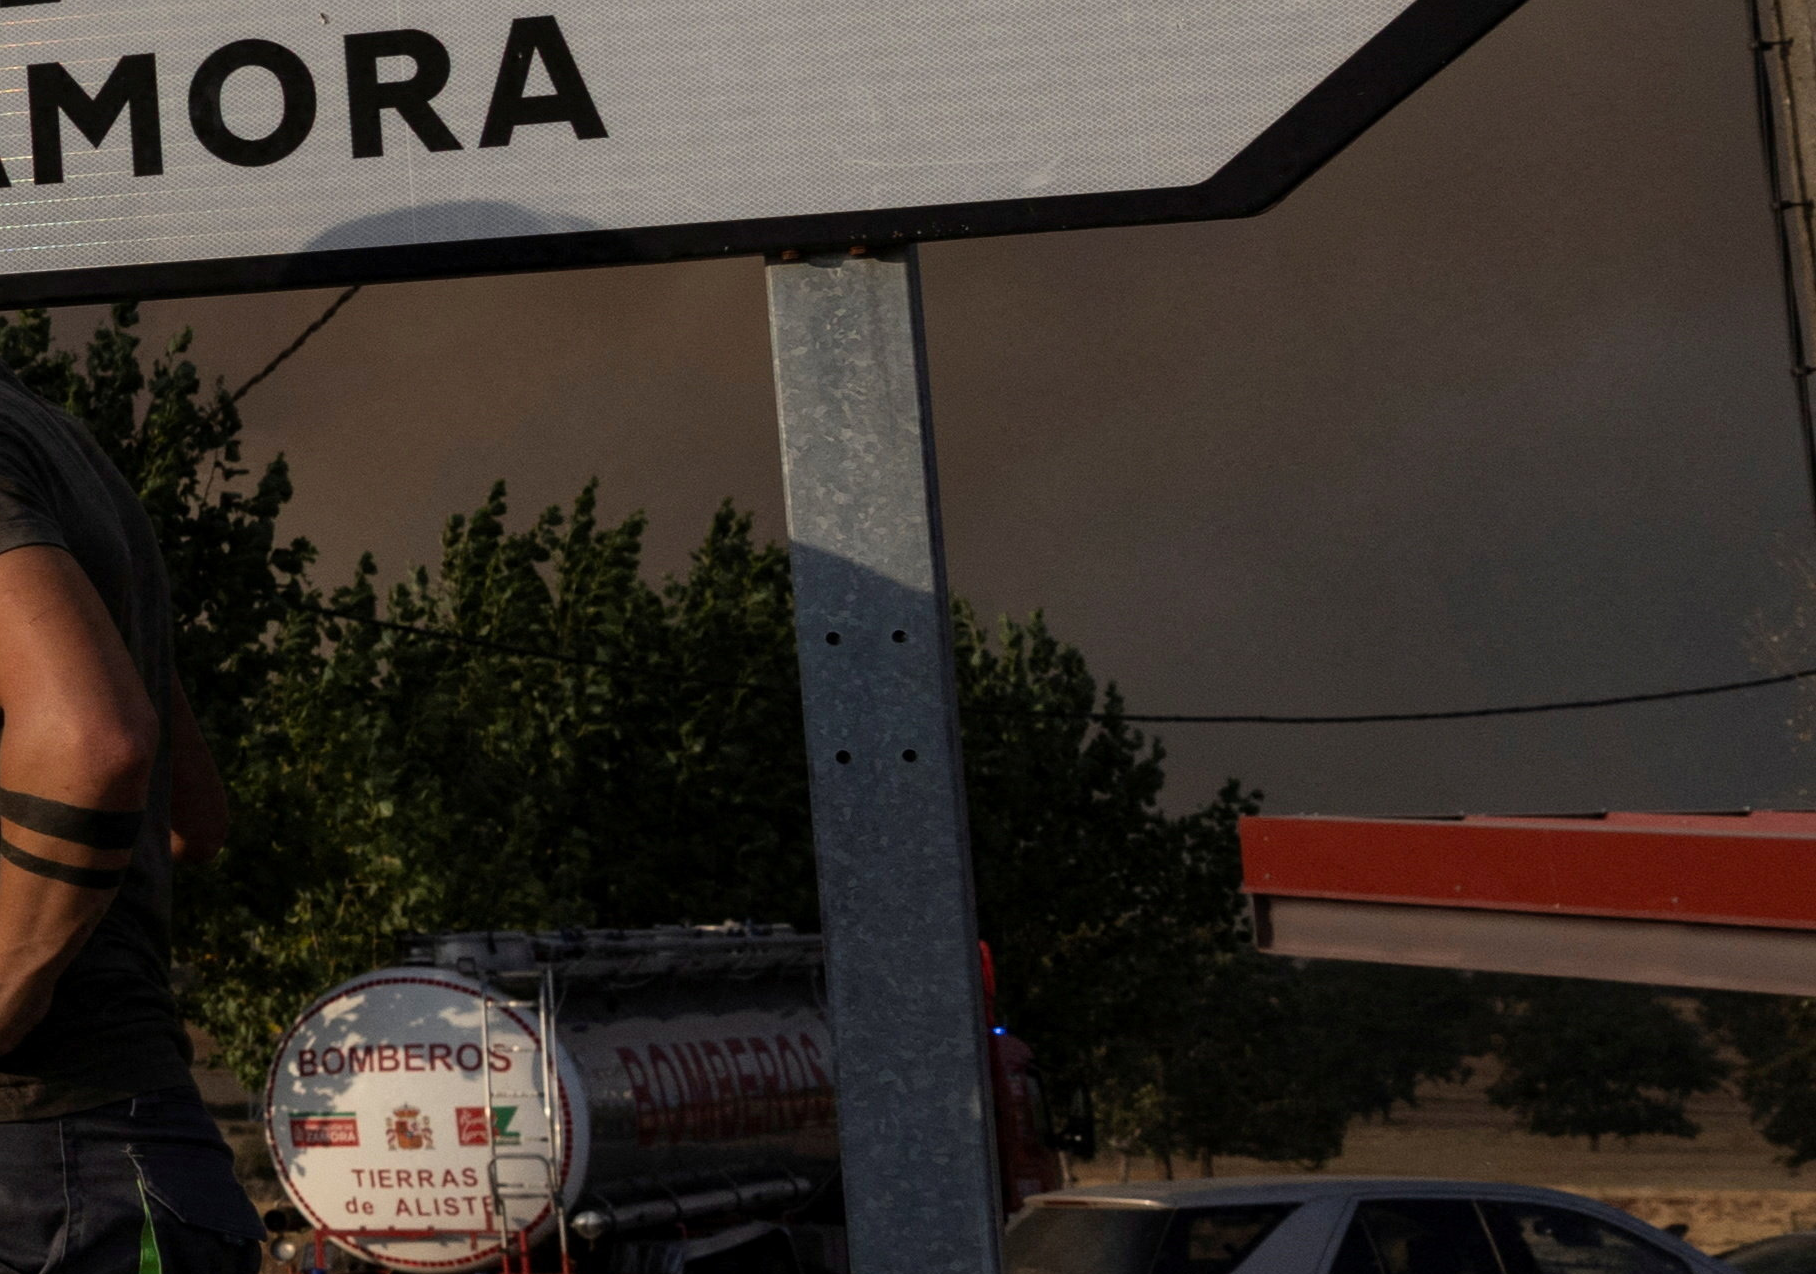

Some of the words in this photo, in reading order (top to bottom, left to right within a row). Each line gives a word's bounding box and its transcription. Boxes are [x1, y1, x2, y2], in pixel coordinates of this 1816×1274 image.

[298, 1042, 513, 1077] BOMBEROS
[351, 1168, 479, 1189] TIERRAS
[345, 1197, 374, 1216] de
[395, 1195, 496, 1217] ALISTE
